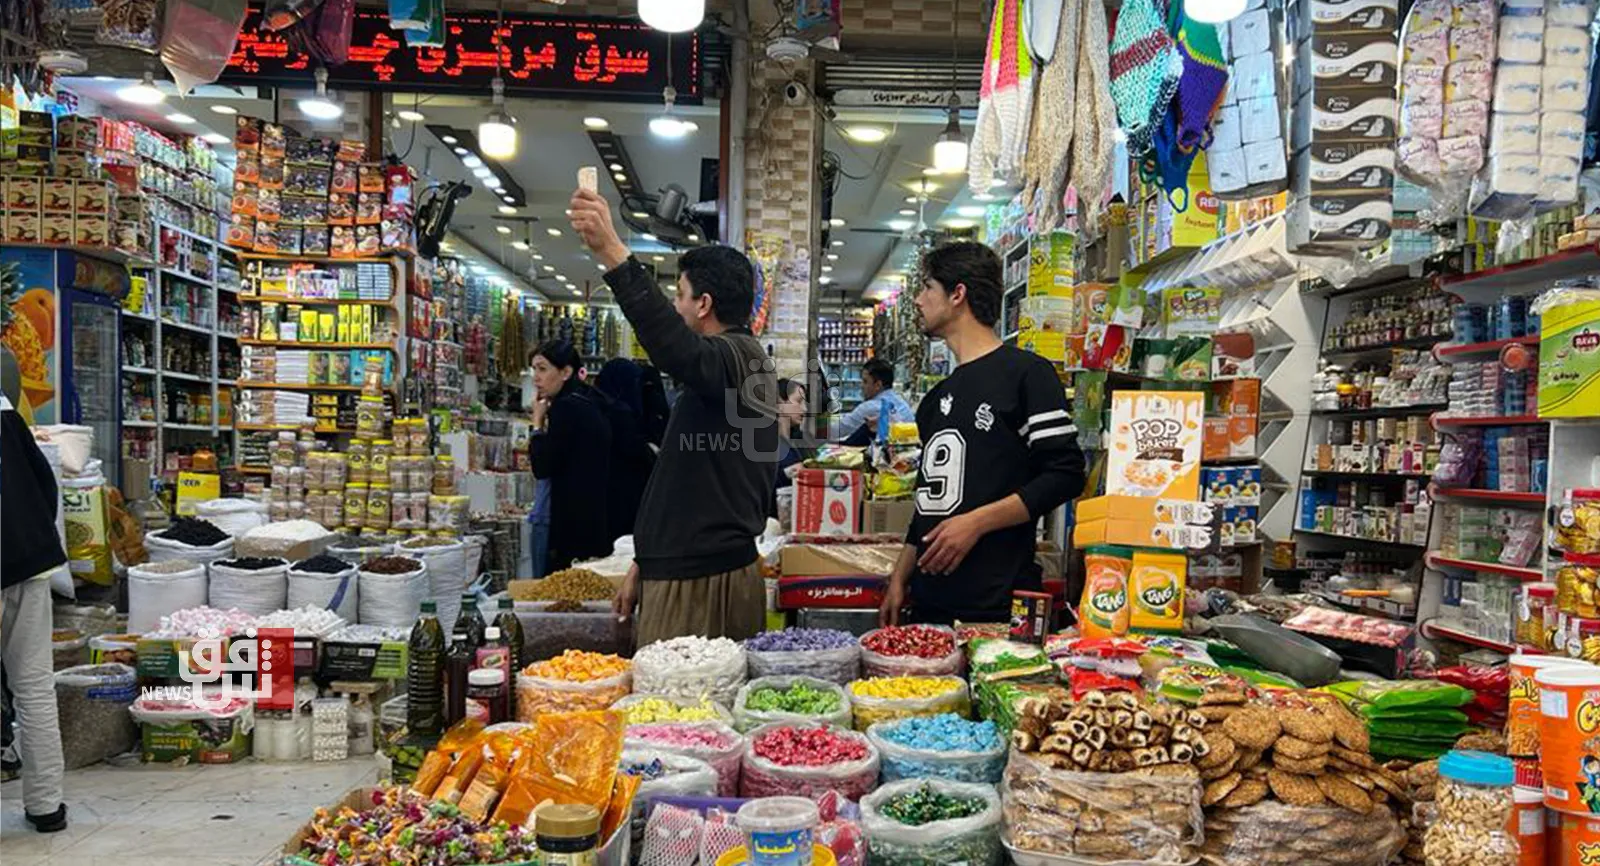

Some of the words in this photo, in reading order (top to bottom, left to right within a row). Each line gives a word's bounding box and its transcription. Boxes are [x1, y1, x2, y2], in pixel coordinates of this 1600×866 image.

[574, 31, 649, 83] سوق
[1131, 418, 1182, 440] POP
[915, 428, 967, 516] 9
[1093, 590, 1126, 612] TANG
[1142, 588, 1174, 604] TANG
